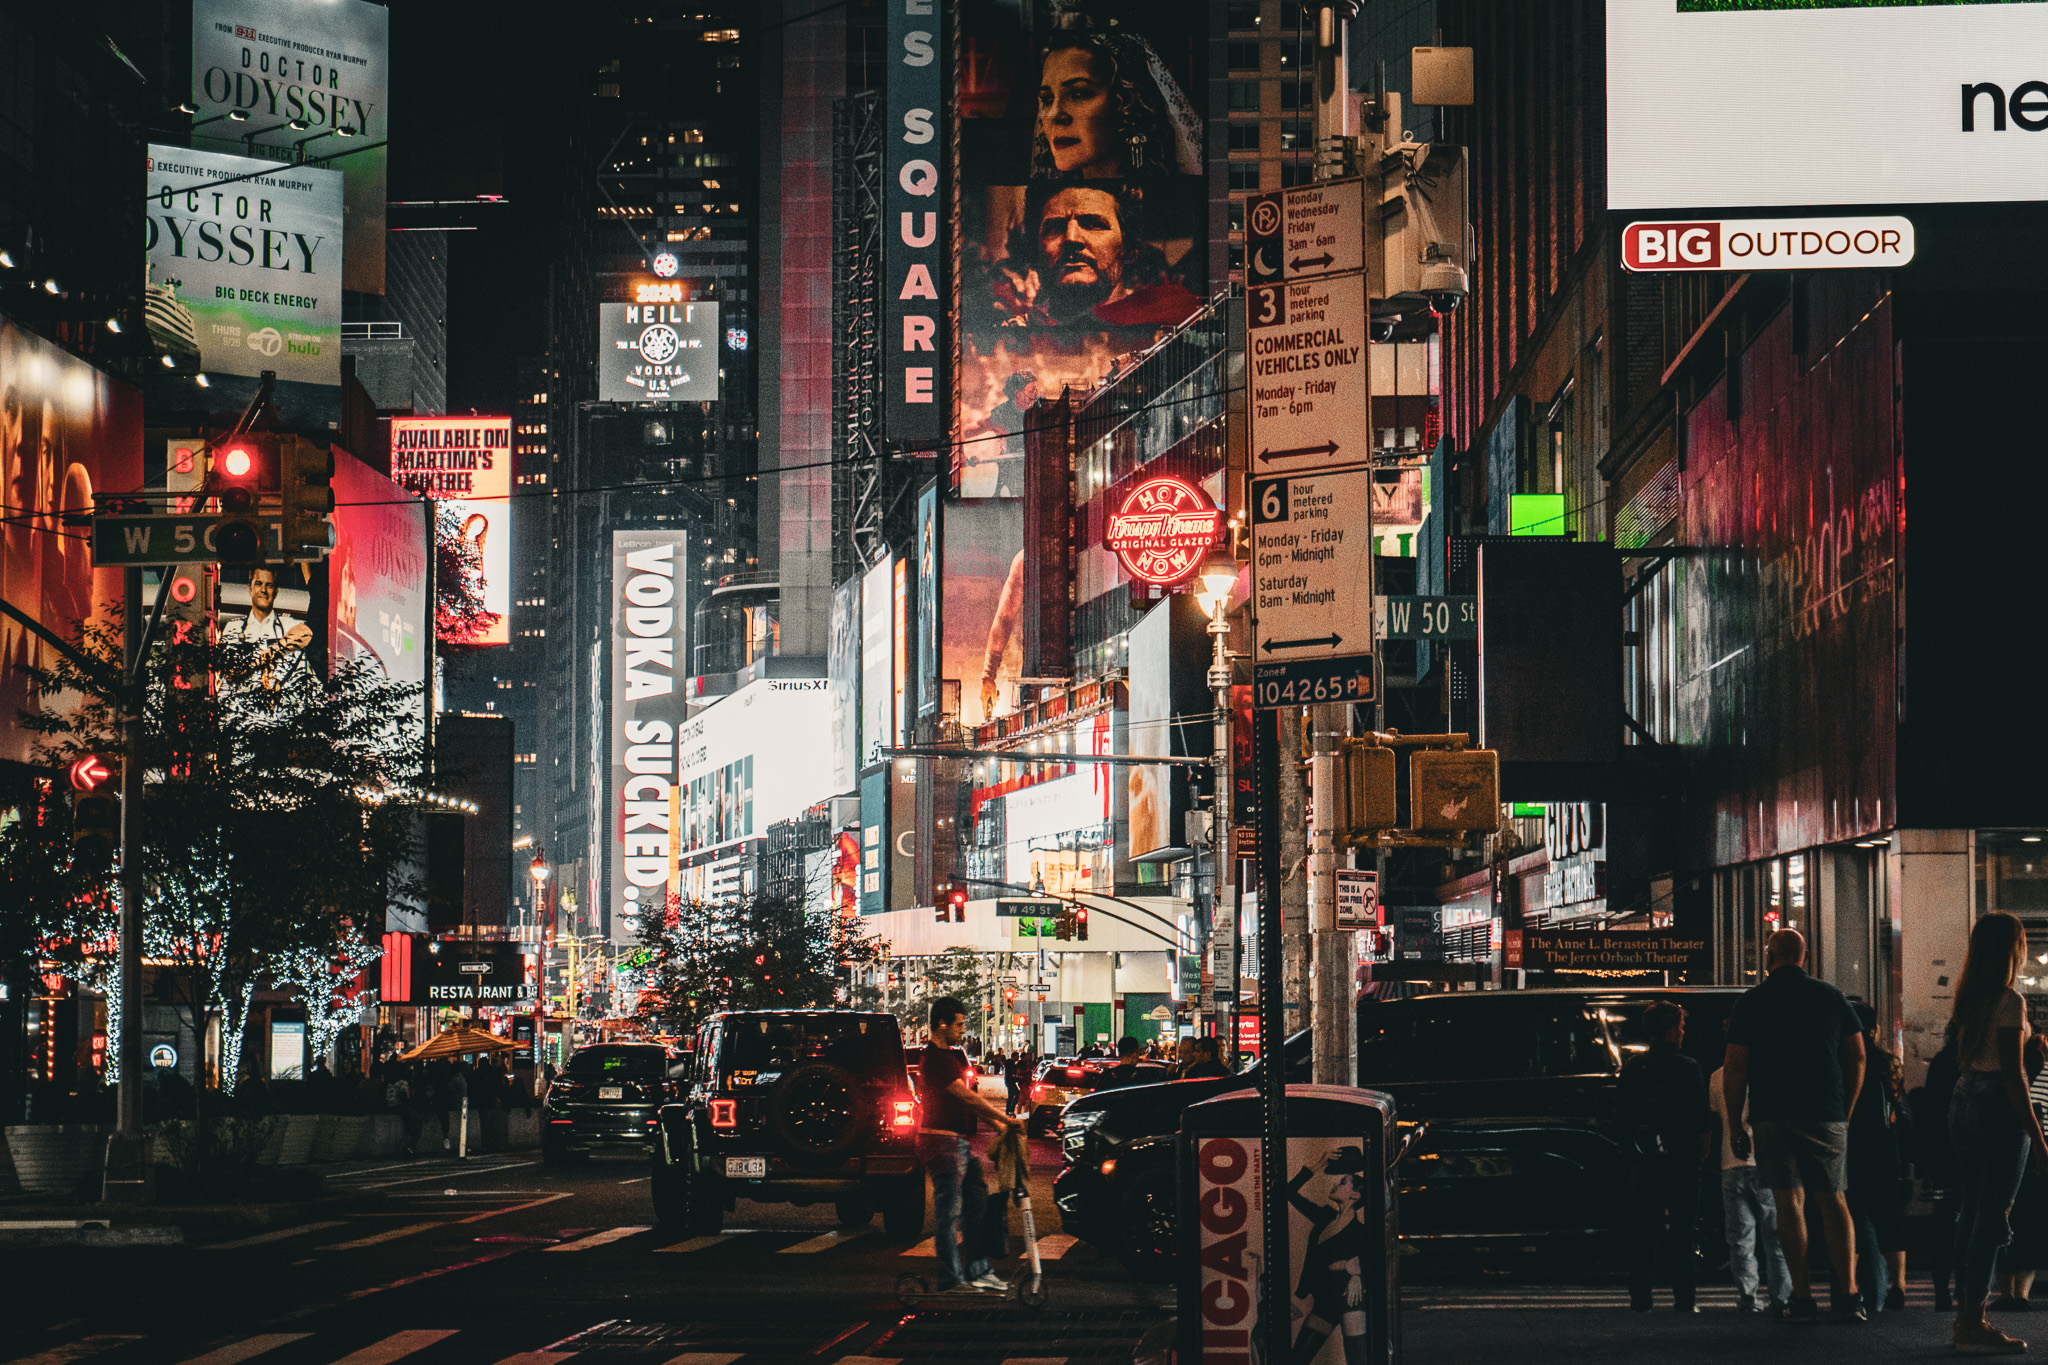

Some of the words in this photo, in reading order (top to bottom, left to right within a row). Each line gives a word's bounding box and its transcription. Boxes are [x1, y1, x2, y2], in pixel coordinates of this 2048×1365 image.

[215, 22, 232, 34] FROM
[258, 33, 291, 49] EXECUTIVE
[293, 42, 324, 56] PRODUCER
[326, 49, 341, 60] RYAN
[343, 53, 367, 67] MURPHY
[242, 47, 338, 90] DOCTOR
[204, 66, 375, 136] ODYSSEY
[270, 146, 292, 161] DECK
[157, 161, 204, 177] EXECUTIVE
[254, 176, 276, 188] RYAN
[278, 179, 313, 192] MURPHY
[161, 185, 272, 223] OCTOR
[1287, 192, 1323, 206] Monday
[1287, 203, 1339, 220] Wednesday
[1288, 222, 1315, 234] Friday
[1288, 239, 1307, 251] 3am
[1316, 235, 1336, 247] 6am
[1638, 228, 1712, 263] BIG
[1728, 229, 1902, 257] OUTDOOR
[899, 108, 938, 403] SQUARE
[216, 286, 235, 300] BIG
[240, 289, 270, 304] DECK
[274, 293, 318, 309] ENERGY
[637, 285, 682, 302] 2024
[1289, 285, 1311, 297] hour
[1258, 288, 1277, 323] 3
[1290, 294, 1329, 310] metered
[1290, 309, 1325, 325] parking
[211, 324, 241, 337] THURS
[222, 337, 241, 348] 9/26
[288, 340, 321, 356] hulu
[1255, 328, 1344, 355] COMMERCIAL
[635, 365, 682, 376] VODKA
[1256, 352, 1320, 376] VEHICLES
[1324, 347, 1359, 367] ONLY
[648, 380, 670, 391] U.S.
[1256, 385, 1295, 401] Monday
[1305, 380, 1336, 395] Friday
[1256, 405, 1278, 418] 7am
[1289, 402, 1313, 416] 6pm
[398, 429, 480, 449] AVAILABLE
[484, 429, 509, 449] ON
[397, 450, 493, 470] MARTINA'S
[1138, 487, 1186, 509] HOT
[1293, 485, 1314, 495] hour
[1262, 483, 1280, 520] 6
[1293, 493, 1333, 508] metered
[1293, 507, 1328, 522] parking
[1108, 513, 1164, 539] Krispy
[1161, 511, 1217, 537] Kreme
[124, 526, 151, 554] W
[618, 540, 651, 548] LeBron
[1112, 539, 1166, 549] ORIGINAL
[1170, 537, 1212, 547] GLAZED
[1258, 533, 1300, 549] Monday
[1311, 528, 1344, 543] Friday
[1137, 550, 1187, 575] NOW
[1259, 553, 1282, 568] 6pm
[1292, 545, 1335, 563] Midnight
[1260, 575, 1308, 591] Saturday
[1260, 595, 1282, 608] 8am
[1292, 588, 1335, 605] Midnight
[625, 544, 674, 701] VODKA
[1391, 602, 1410, 633] W
[1423, 602, 1449, 633] 50
[1461, 602, 1474, 622] St
[1257, 667, 1286, 678] Zone#
[1258, 676, 1342, 704] 104265
[1545, 801, 1591, 861] GIFTS
[1339, 885, 1349, 893] THIS
[1351, 885, 1355, 893] IS
[1356, 885, 1360, 893] A
[1350, 896, 1362, 904] FREE
[1009, 905, 1017, 914] W
[1021, 905, 1035, 914] 49
[1040, 906, 1051, 914] St
[1529, 938, 1552, 949] The
[1555, 938, 1586, 949] Anne
[1604, 938, 1658, 949] Bernstein
[1661, 938, 1704, 949] Theater
[1545, 952, 1567, 963] The
[1570, 952, 1598, 966] Jerry
[1600, 952, 1642, 963] Orbach
[1644, 952, 1689, 963] Theater
[1199, 1138, 1249, 1365] ICAGO
